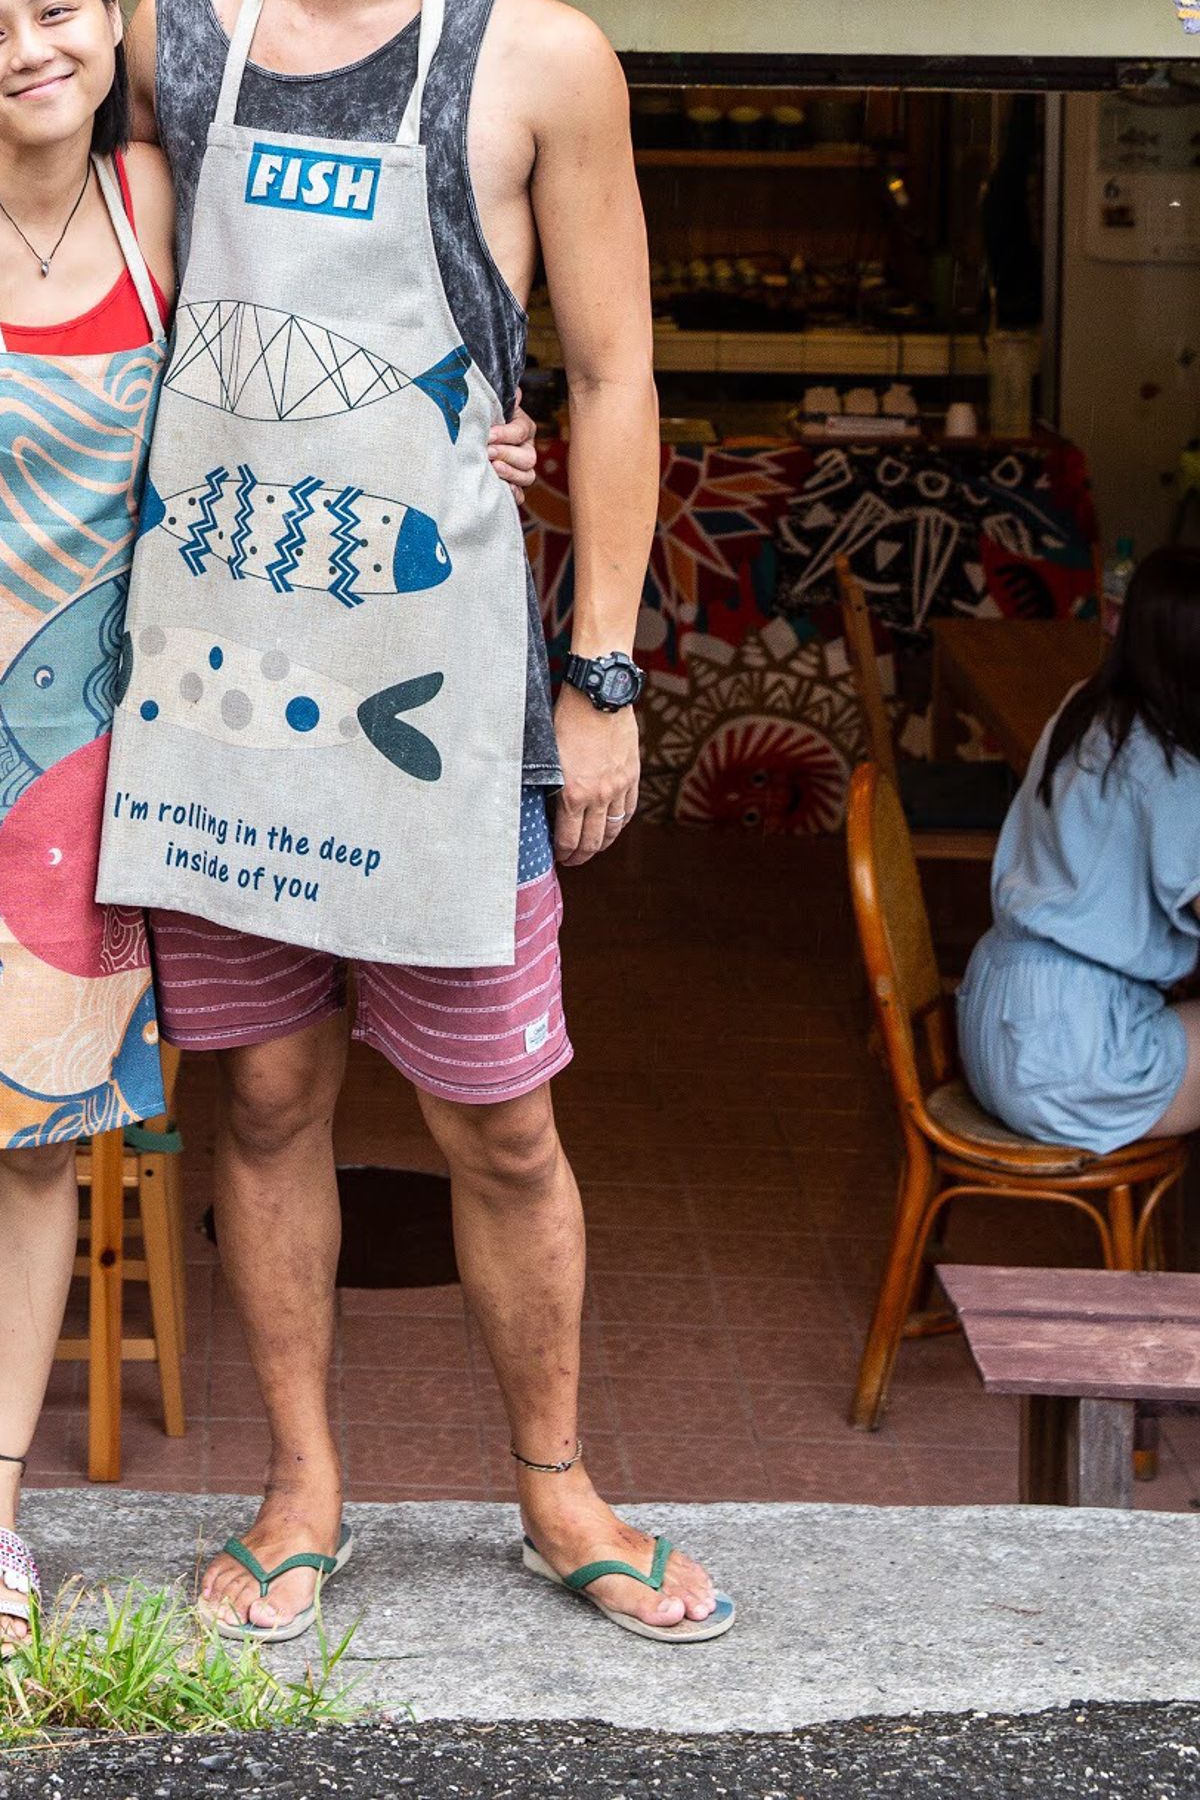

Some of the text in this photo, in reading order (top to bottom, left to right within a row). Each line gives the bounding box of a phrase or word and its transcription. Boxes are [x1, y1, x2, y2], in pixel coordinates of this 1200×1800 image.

[251, 154, 374, 211] FISH
[114, 792, 381, 876] I'm rolling in the deep
[165, 841, 319, 901] inside of you
